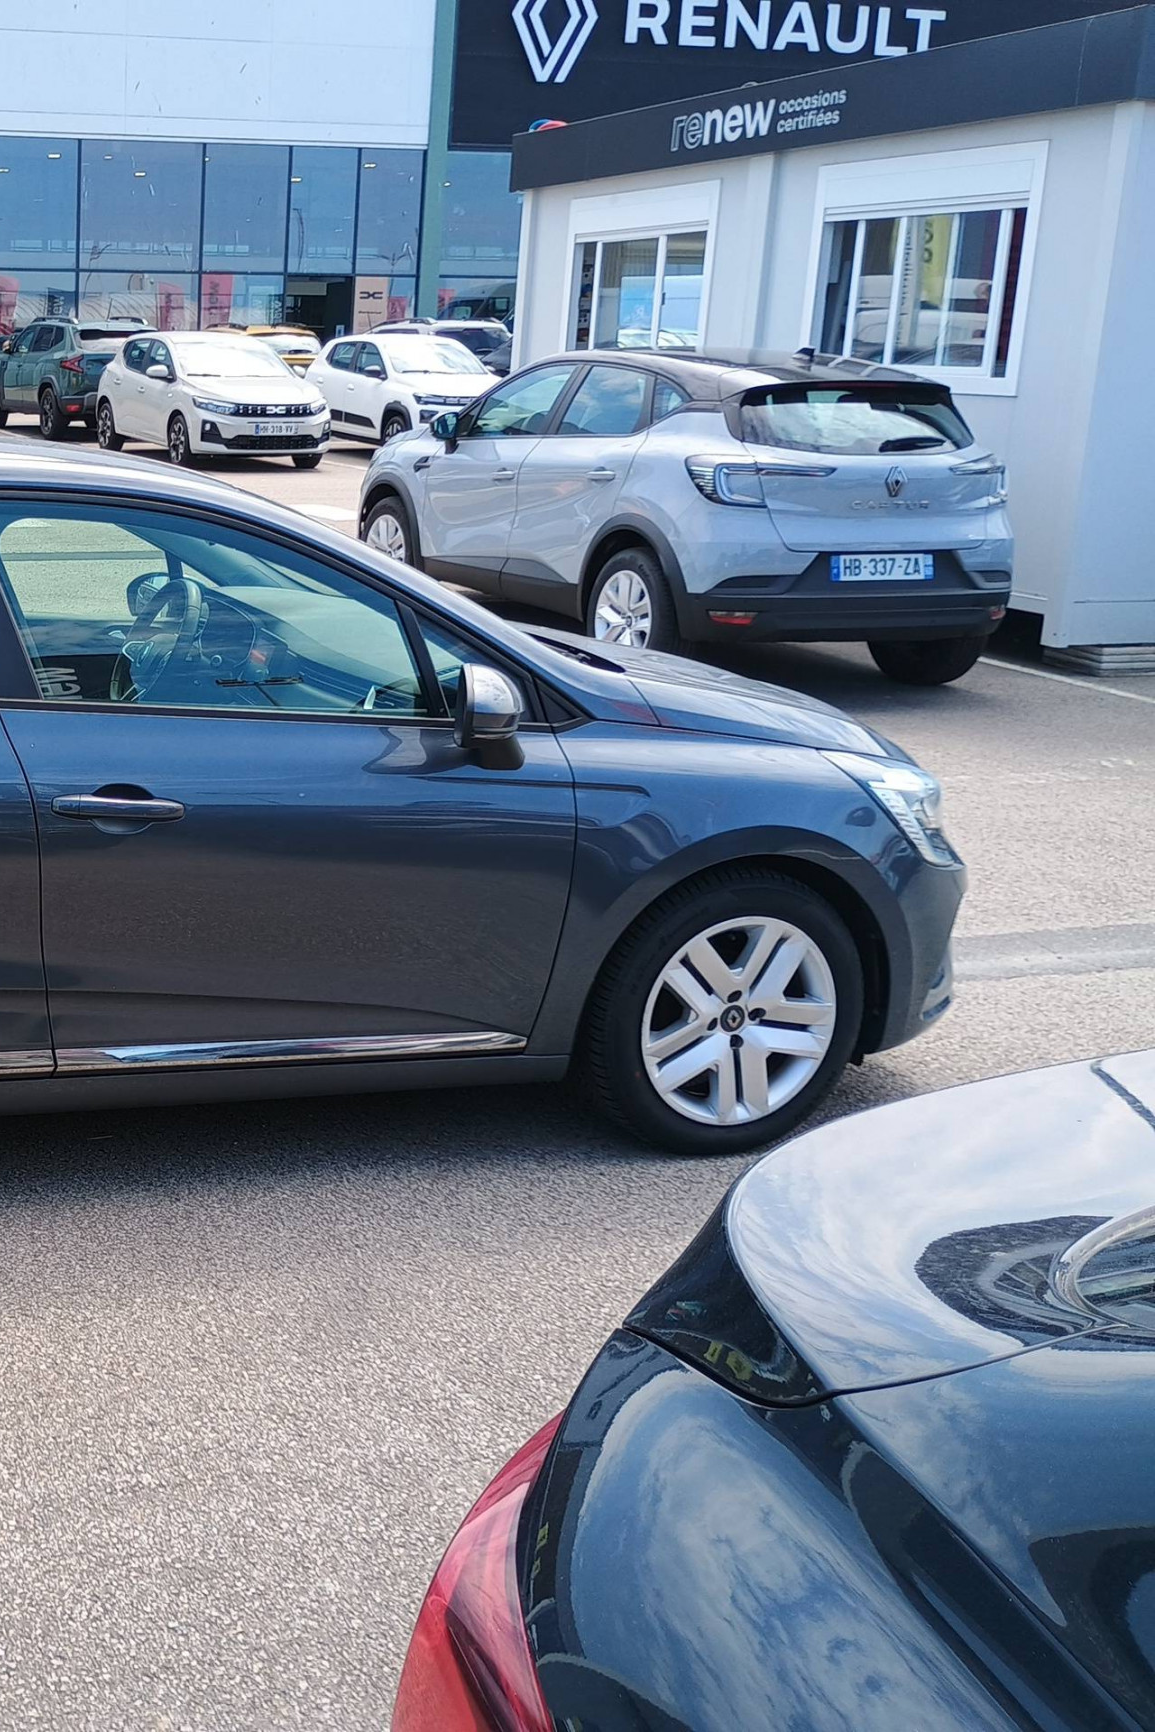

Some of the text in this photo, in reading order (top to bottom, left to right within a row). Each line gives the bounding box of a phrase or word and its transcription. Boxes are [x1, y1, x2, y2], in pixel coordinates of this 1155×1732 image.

[624, 0, 947, 57] RENAULT
[778, 89, 847, 115] occasions
[670, 98, 776, 152] renew
[776, 108, 840, 134] certifiées
[842, 557, 922, 577] HB-337-ZA
